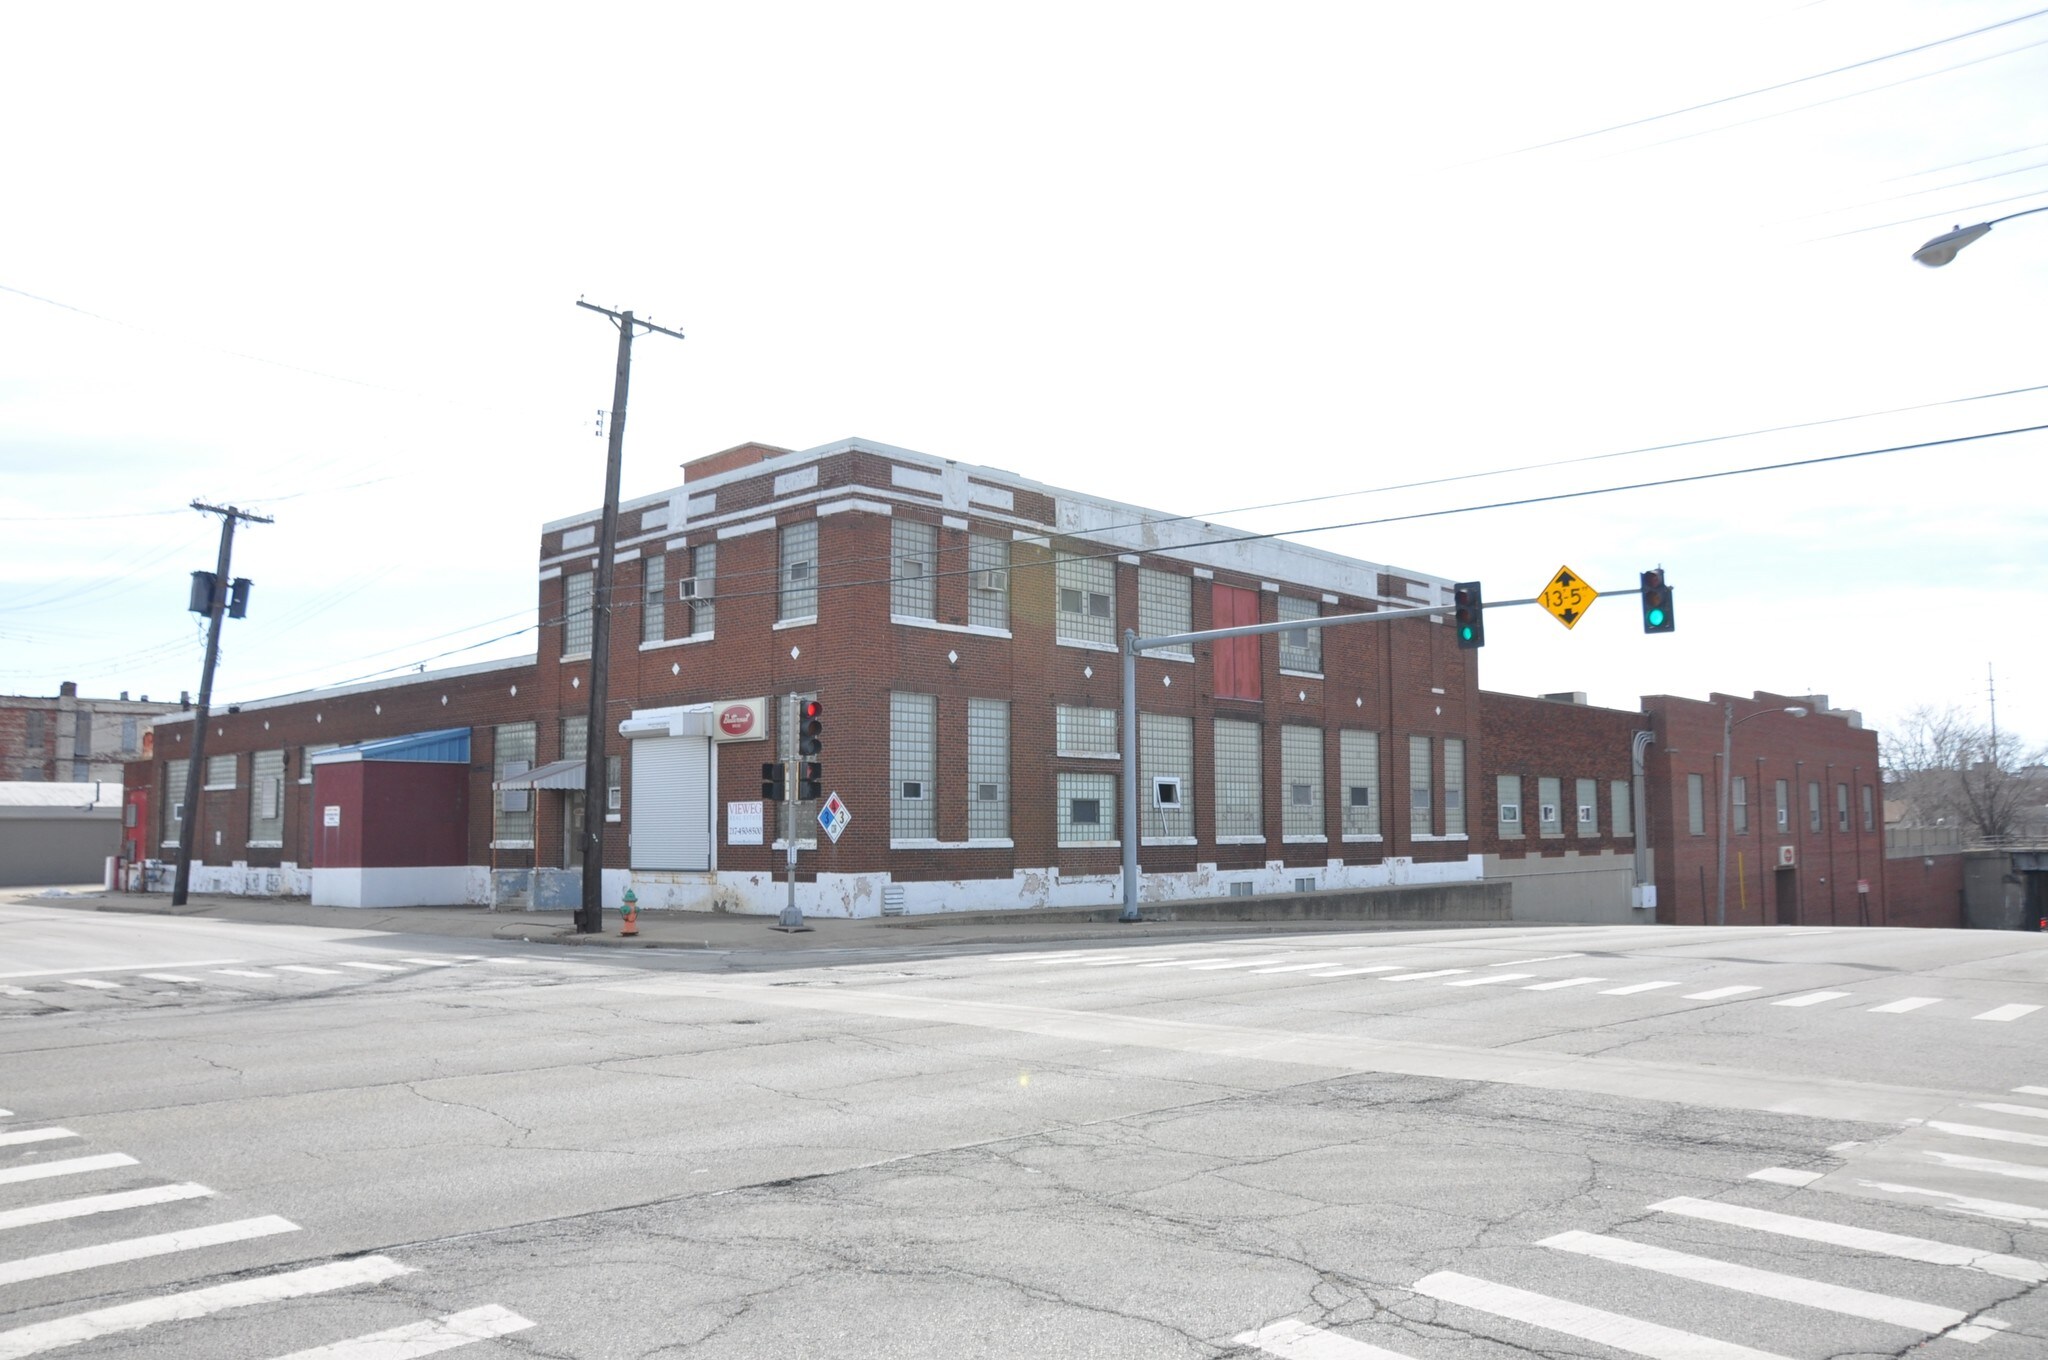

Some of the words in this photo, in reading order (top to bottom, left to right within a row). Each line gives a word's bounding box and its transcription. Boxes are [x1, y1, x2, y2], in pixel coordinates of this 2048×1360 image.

[729, 803, 762, 814] VIEWEG
[824, 811, 830, 824] 3
[839, 811, 845, 824] 3
